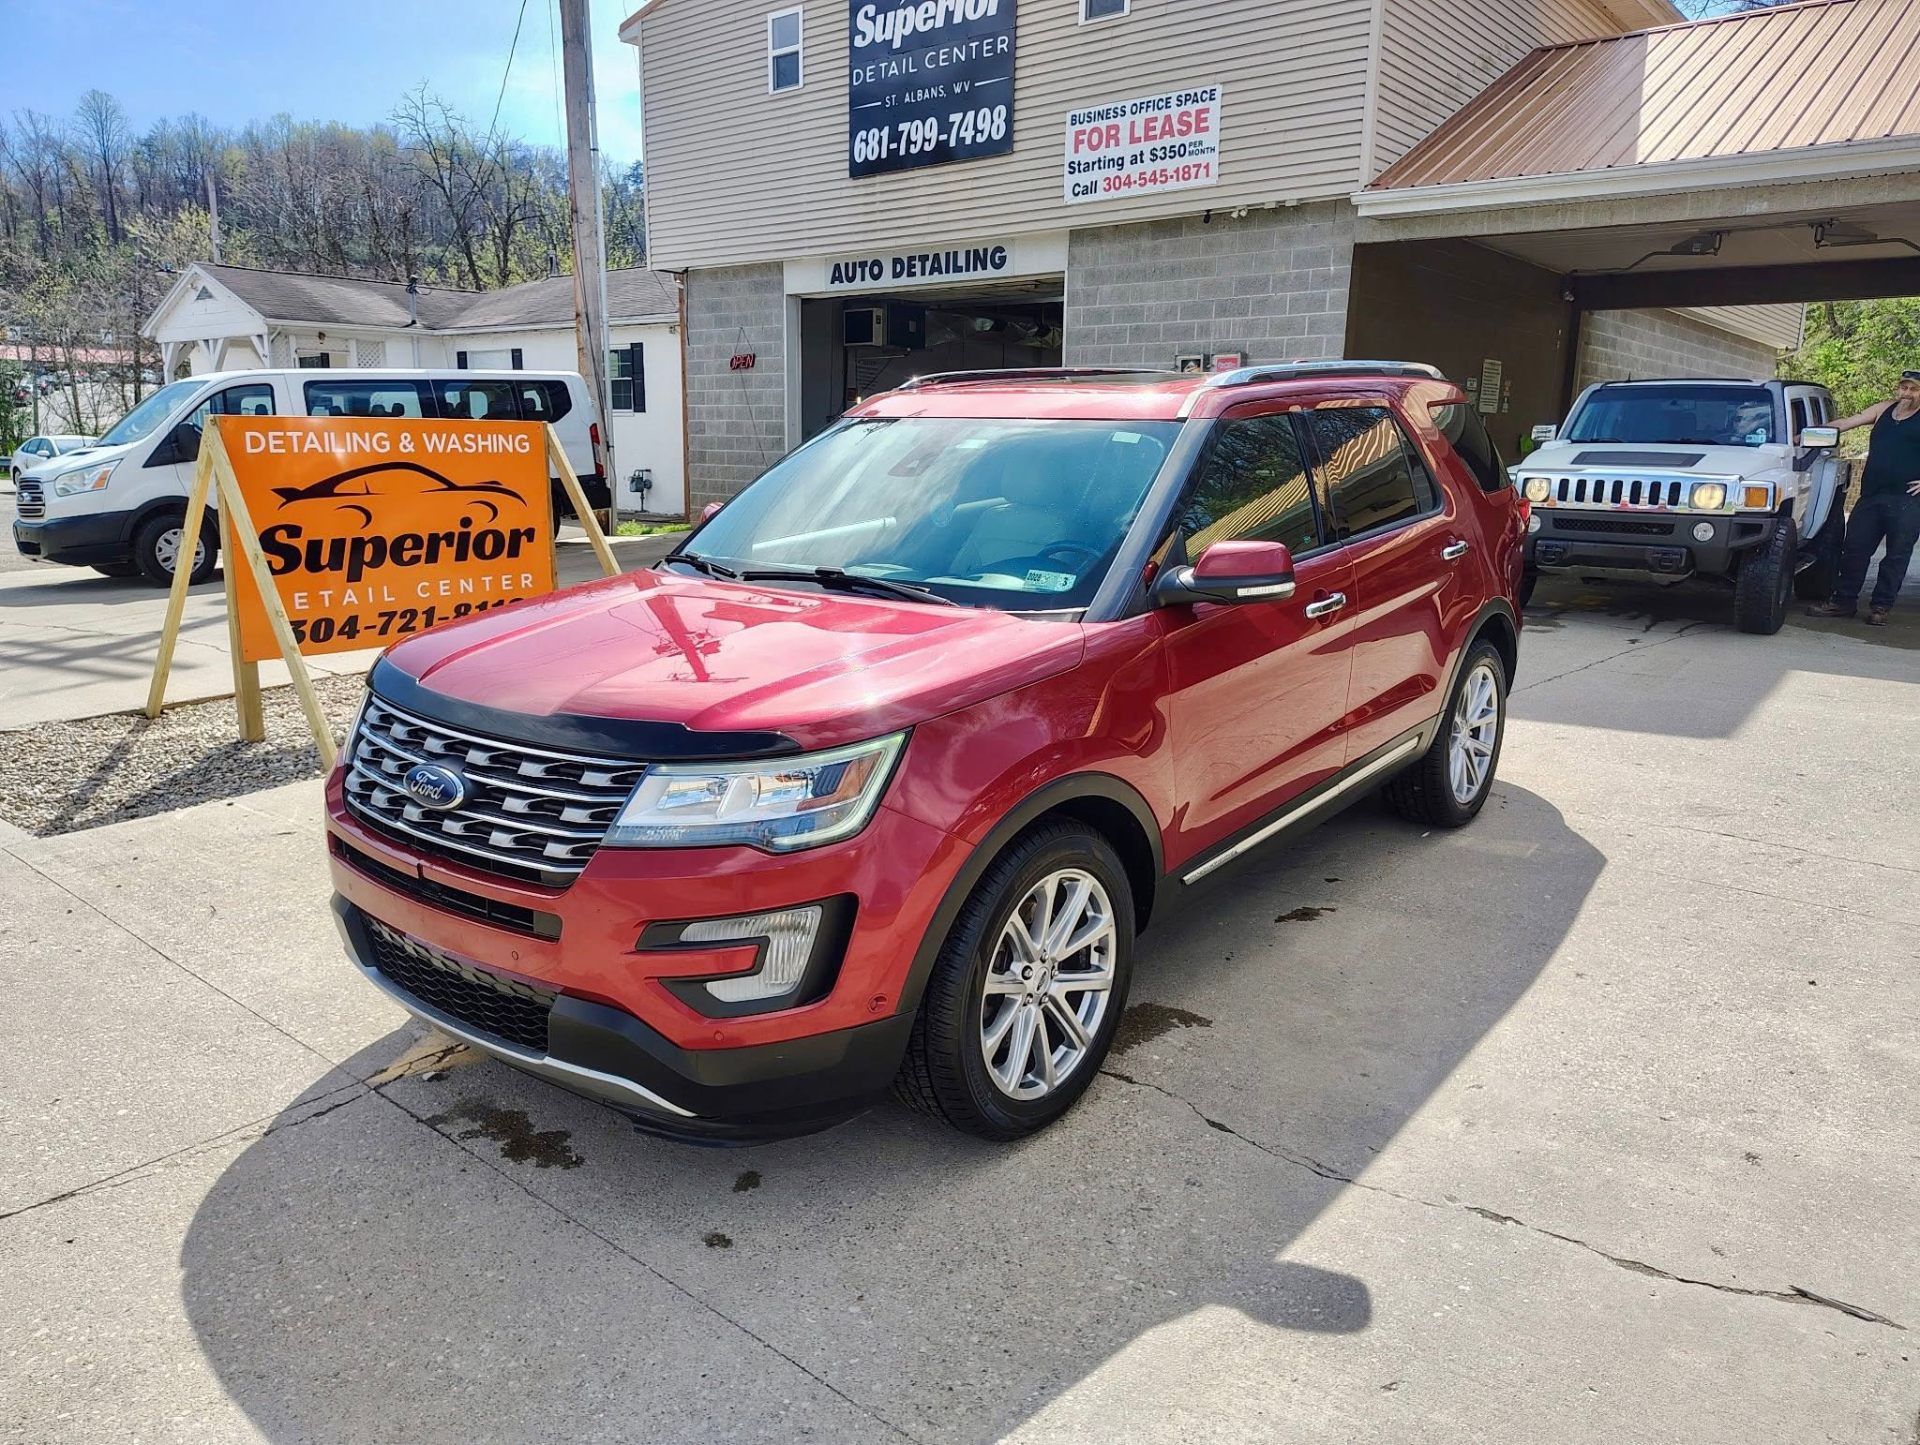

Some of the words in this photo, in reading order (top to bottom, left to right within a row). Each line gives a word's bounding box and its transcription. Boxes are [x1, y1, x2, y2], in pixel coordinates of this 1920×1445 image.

[853, 56, 918, 86] DETAIL
[925, 35, 1009, 69] CENTER
[885, 95, 898, 108] ST.
[904, 85, 947, 104] ALBANS,
[953, 80, 970, 95] WV
[1070, 105, 1127, 126] BUSINESS
[1130, 96, 1172, 116] OFFICE
[1175, 88, 1217, 107] SPACE
[853, 104, 1007, 164] 681-799-7498
[1073, 124, 1120, 154] FOR
[1129, 107, 1210, 145] LEASE
[1188, 140, 1203, 148] PER
[1068, 154, 1124, 175] Starting
[1130, 150, 1144, 166] at
[1149, 143, 1187, 164] $350
[1188, 146, 1215, 157] MONTH
[1072, 180, 1097, 197] Call
[830, 259, 883, 284] AUTO
[892, 246, 1007, 279] DETAILING
[244, 431, 390, 454] DETAILING
[399, 432, 415, 453] &
[422, 433, 530, 453] WASHING
[258, 516, 535, 582] Superior
[294, 585, 395, 610] ETAIL
[416, 573, 534, 598] CENTER
[289, 597, 525, 644] 304-721-8
[410, 770, 445, 800] Ford
